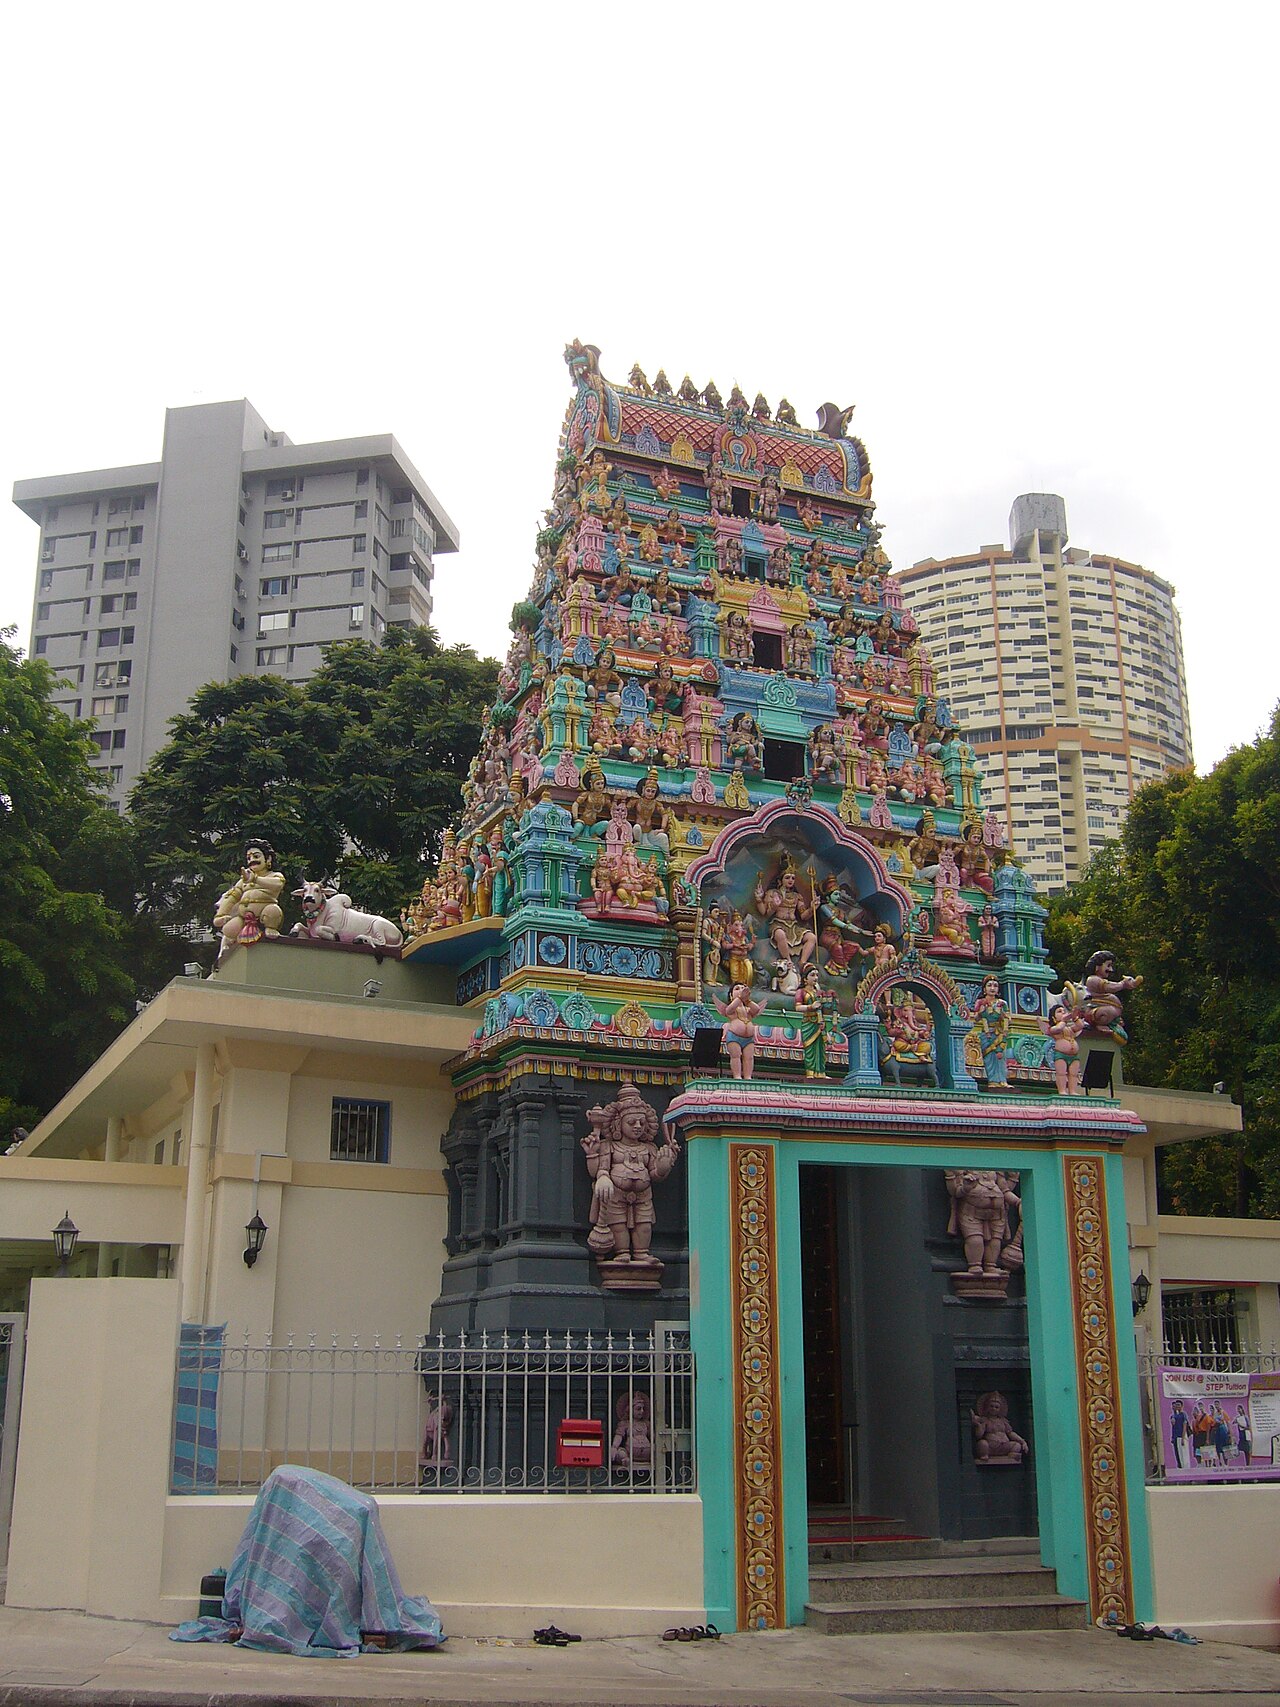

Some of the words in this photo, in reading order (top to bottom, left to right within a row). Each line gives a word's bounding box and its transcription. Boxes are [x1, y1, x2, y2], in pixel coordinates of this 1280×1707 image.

[1165, 1374, 1181, 1382] JOIN
[1182, 1374, 1195, 1382] US!
[1196, 1374, 1204, 1384] @
[1205, 1383, 1224, 1391] STEP
[1225, 1383, 1246, 1391] Tuition
